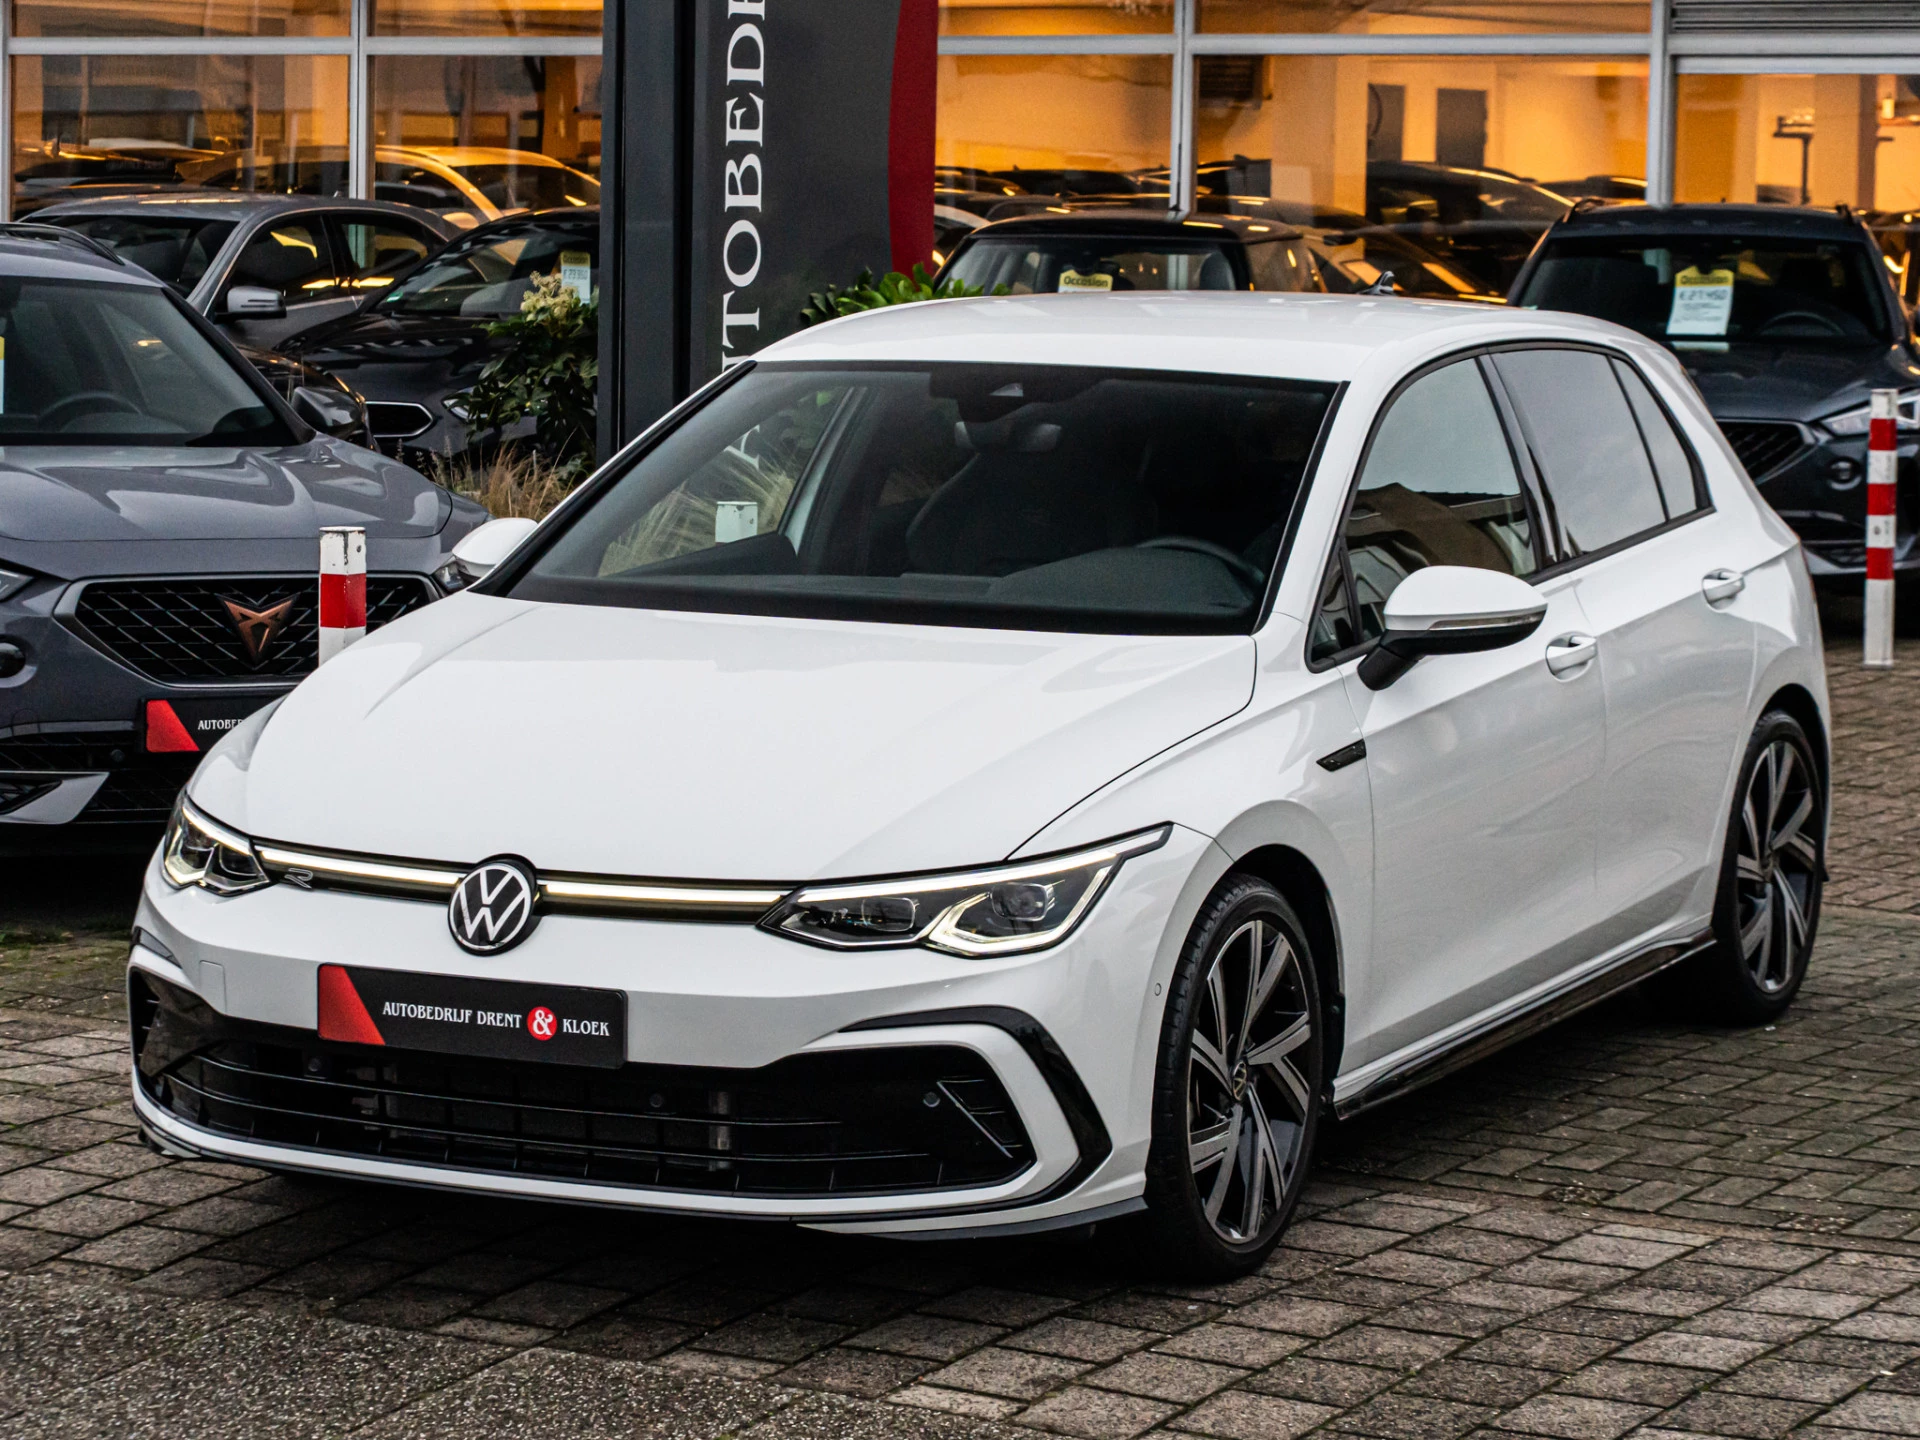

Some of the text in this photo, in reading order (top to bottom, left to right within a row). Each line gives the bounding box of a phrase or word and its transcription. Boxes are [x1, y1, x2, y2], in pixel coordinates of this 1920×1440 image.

[1064, 276, 1109, 287] Occasion
[382, 1001, 611, 1037] AUTOBEDRIJF DRENT & KLOEK
